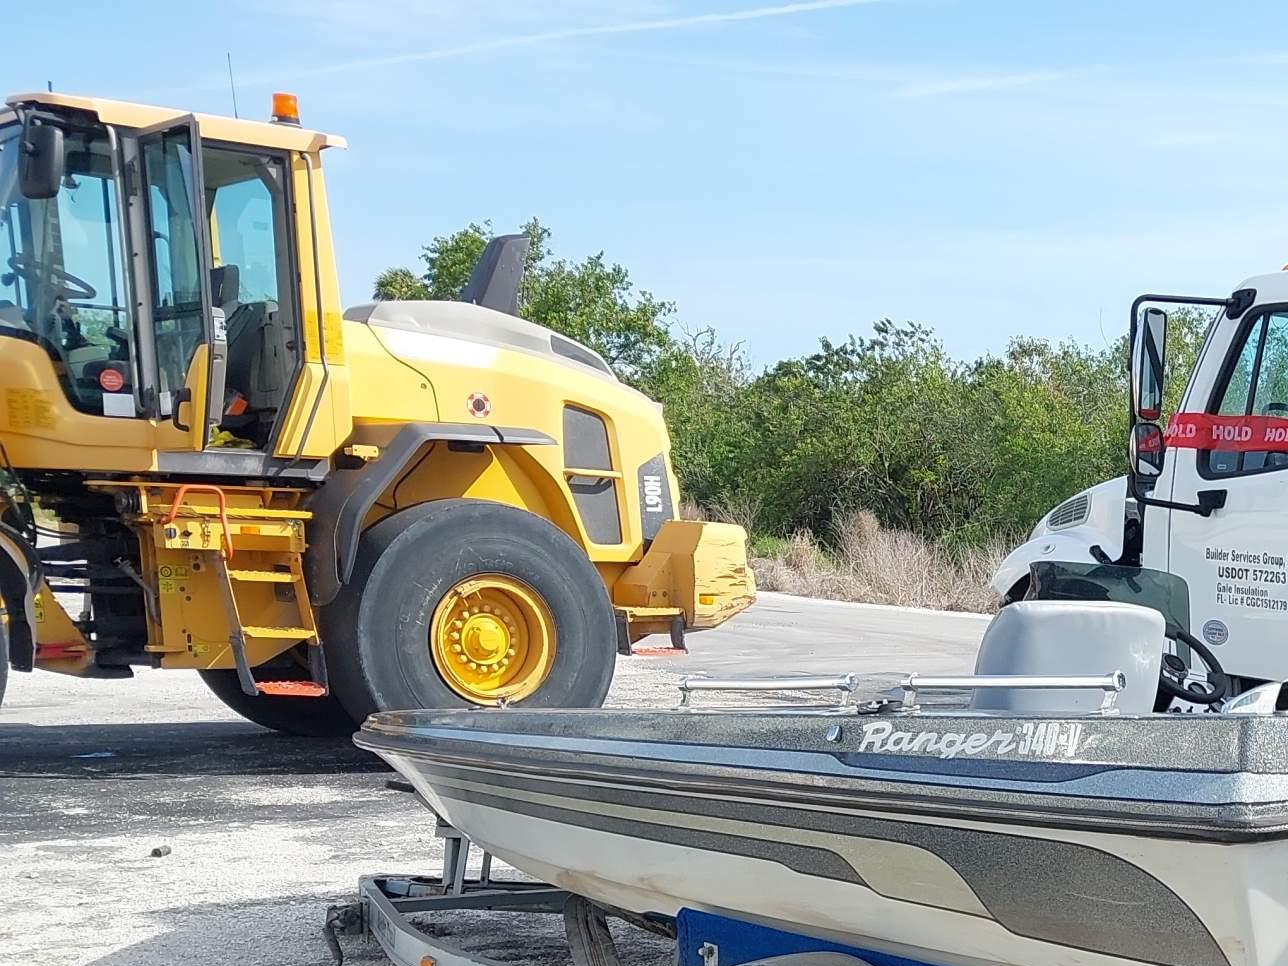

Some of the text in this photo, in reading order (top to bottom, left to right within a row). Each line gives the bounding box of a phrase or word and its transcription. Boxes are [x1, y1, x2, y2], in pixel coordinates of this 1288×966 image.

[1212, 425, 1252, 441] HOLD
[643, 475, 663, 512] L90H
[1205, 547, 1230, 561] Builder
[1231, 550, 1261, 564] Services
[1262, 552, 1286, 569] Group,
[1218, 566, 1287, 584] USDOT 572263
[1216, 582, 1269, 597] Gale Insulation
[1228, 594, 1239, 605] Lic
[858, 721, 1016, 759] Ranger
